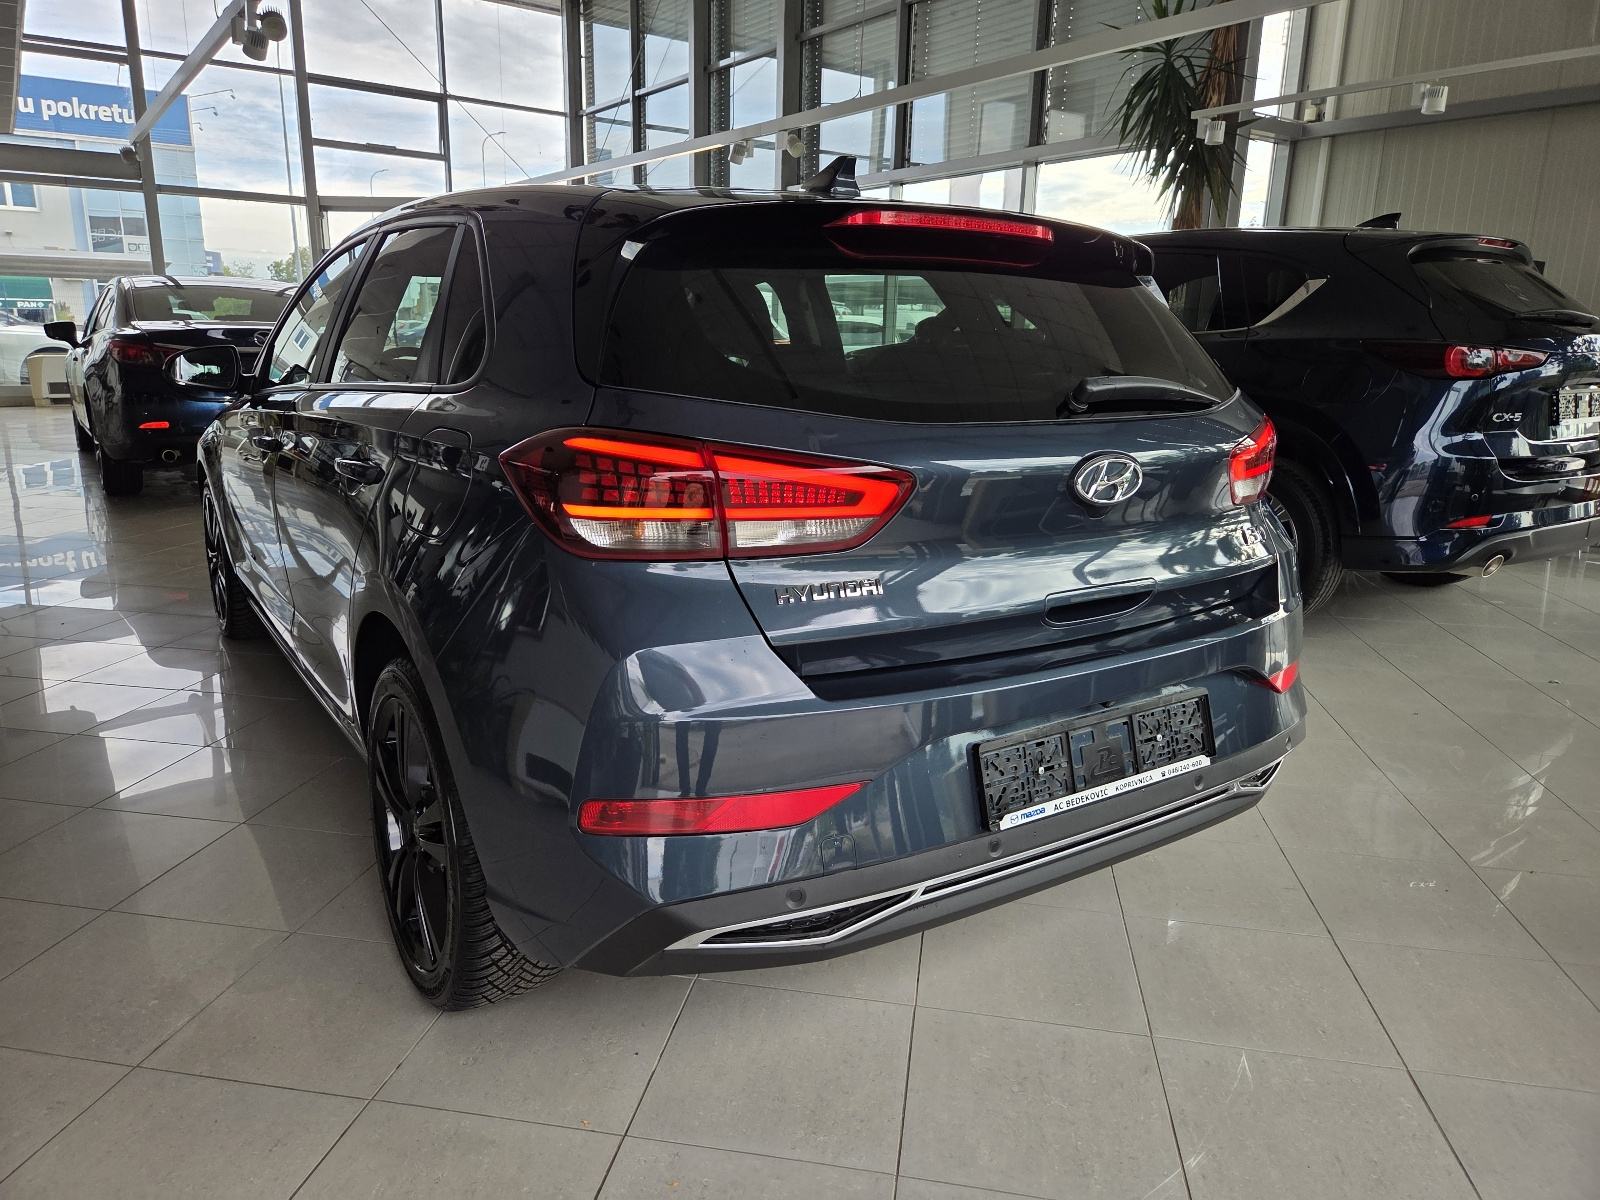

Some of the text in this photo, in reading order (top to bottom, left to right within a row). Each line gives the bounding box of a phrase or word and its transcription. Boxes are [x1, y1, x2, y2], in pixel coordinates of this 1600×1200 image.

[17, 96, 136, 124] u pokretu
[1492, 412, 1523, 423] CX-5
[775, 578, 884, 605] HYUNDAI
[1020, 806, 1046, 821] mazda
[1054, 802, 1064, 812] AC
[1115, 774, 1153, 793] KOPRIVNICA
